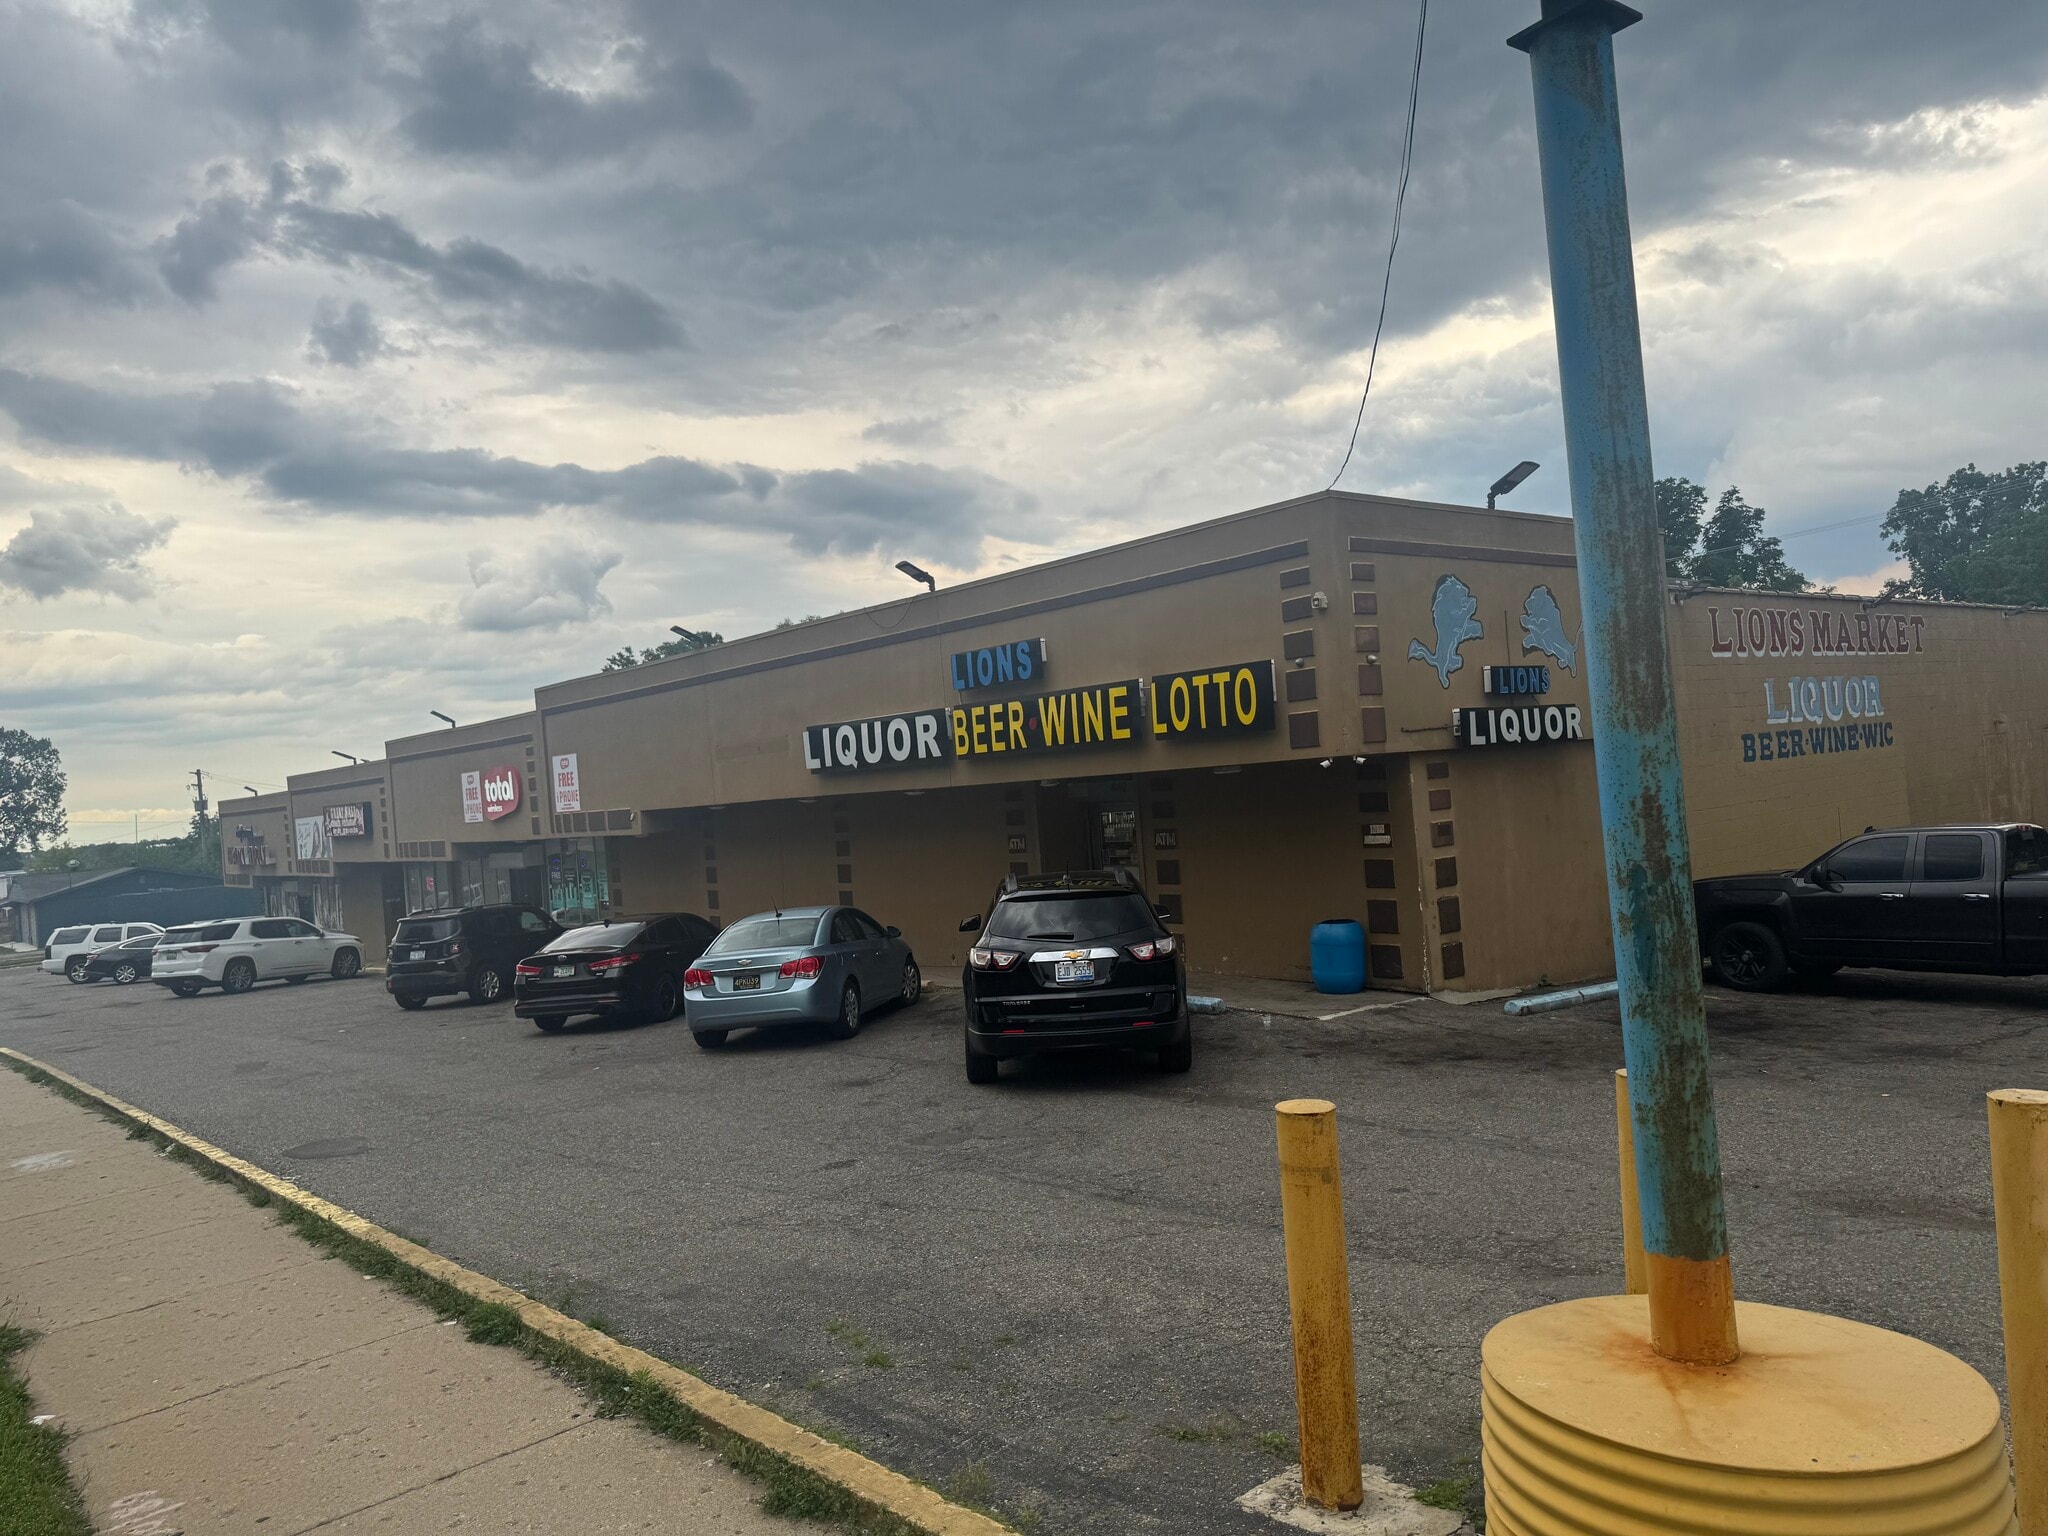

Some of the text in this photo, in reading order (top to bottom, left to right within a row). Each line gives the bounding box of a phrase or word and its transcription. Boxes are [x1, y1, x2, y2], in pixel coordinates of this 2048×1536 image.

[1708, 607, 1925, 657] LIONS MARKET
[951, 641, 1032, 690] LIONS
[1499, 667, 1551, 694] LIONS
[1150, 668, 1257, 734] LOTTO
[1764, 675, 1885, 725] LIQUOR
[952, 686, 1131, 756] BEER WINE
[1469, 706, 1584, 746] LIQUOR
[803, 714, 942, 769] LIQUOR
[1741, 722, 1894, 763] BEER WINE WIC
[465, 787, 478, 801] FREE
[484, 771, 515, 802] total
[558, 771, 575, 788] FREE
[1008, 837, 1025, 851] ATM
[1155, 832, 1176, 847] ATM
[1074, 965, 1091, 976] 2559
